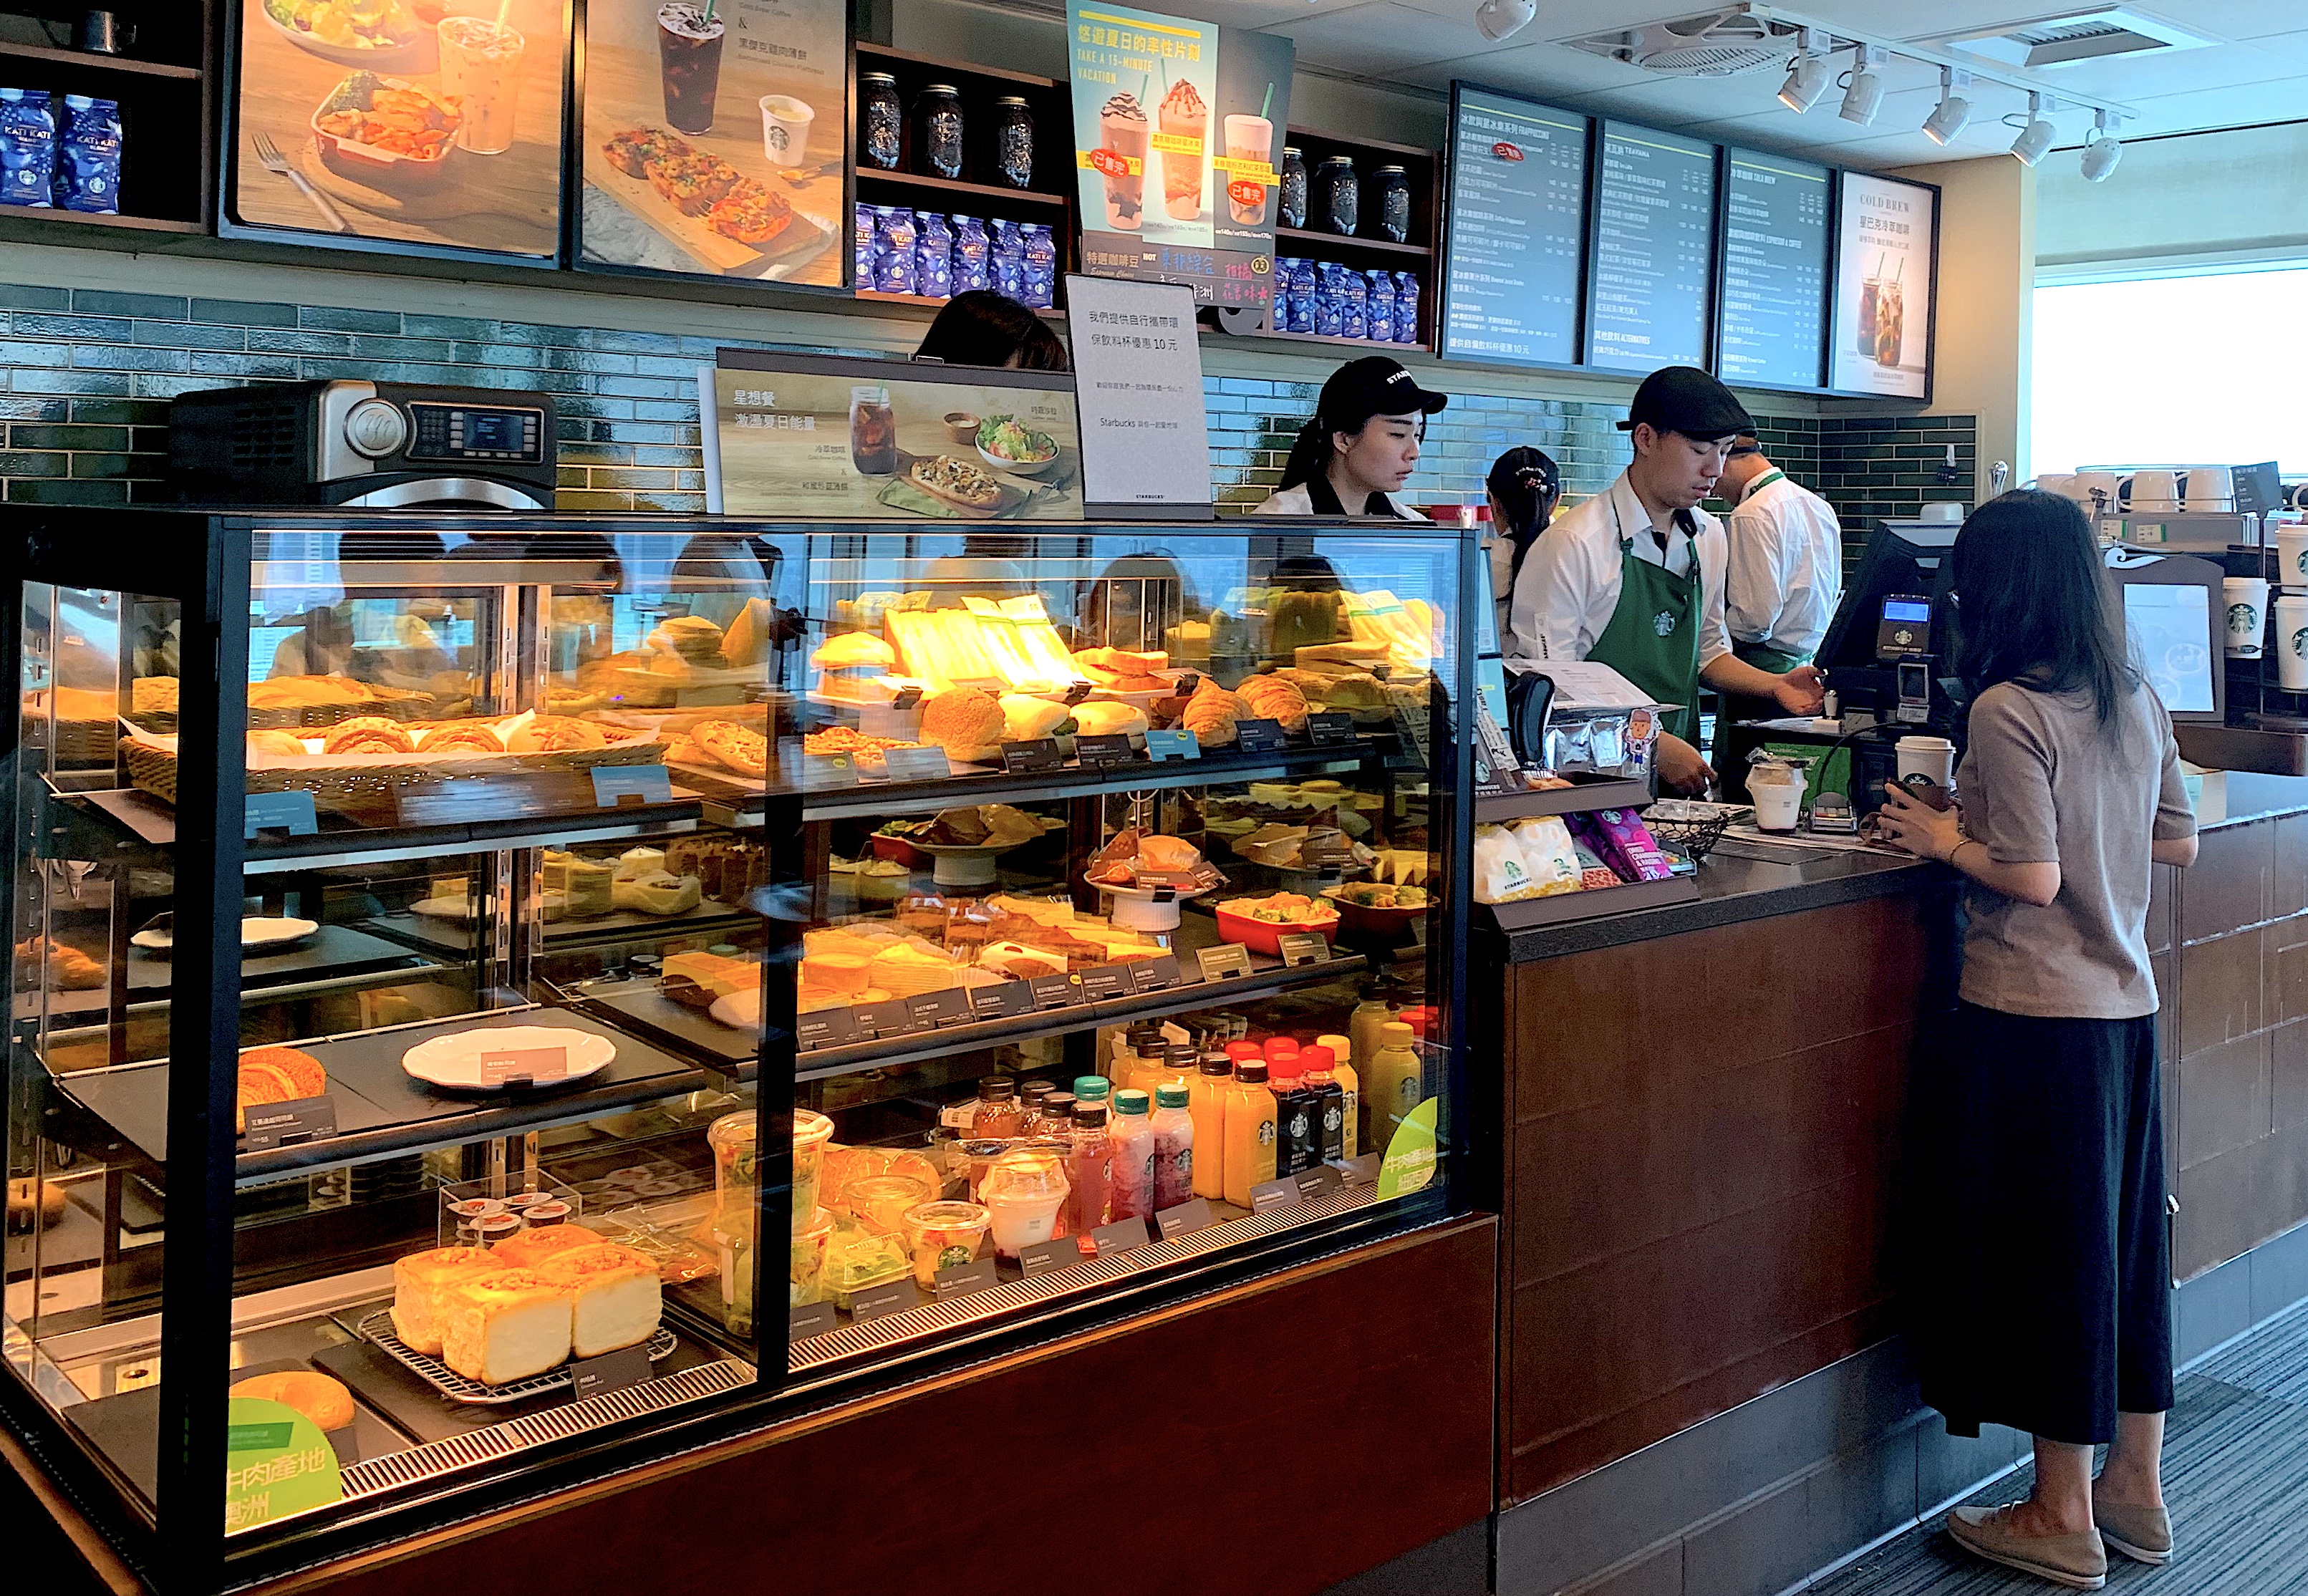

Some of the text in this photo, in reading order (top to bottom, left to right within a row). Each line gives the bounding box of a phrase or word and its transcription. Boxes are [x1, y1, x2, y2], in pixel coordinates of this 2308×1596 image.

[738, 16, 748, 29] &
[1078, 24, 1201, 62] 悠遊夏日的率性片刻
[1077, 49, 1153, 72] TAKE A 15-MINUTE
[1078, 67, 1116, 85] VACATION
[4, 126, 51, 140] KATI KATI
[1093, 151, 1126, 176] 已售完
[1232, 185, 1261, 201] 已售完
[1860, 193, 1909, 213] COLD BREW
[1142, 253, 1157, 261] HOT
[1154, 339, 1165, 349] 10
[1168, 339, 1178, 351] 元
[733, 389, 776, 407] 星想餐
[735, 412, 817, 431] 激盪夏日能量
[1100, 417, 1136, 428] Starbucks
[1504, 877, 1532, 890] STARBUCKS
[1385, 1145, 1436, 1174] 牛肉產地
